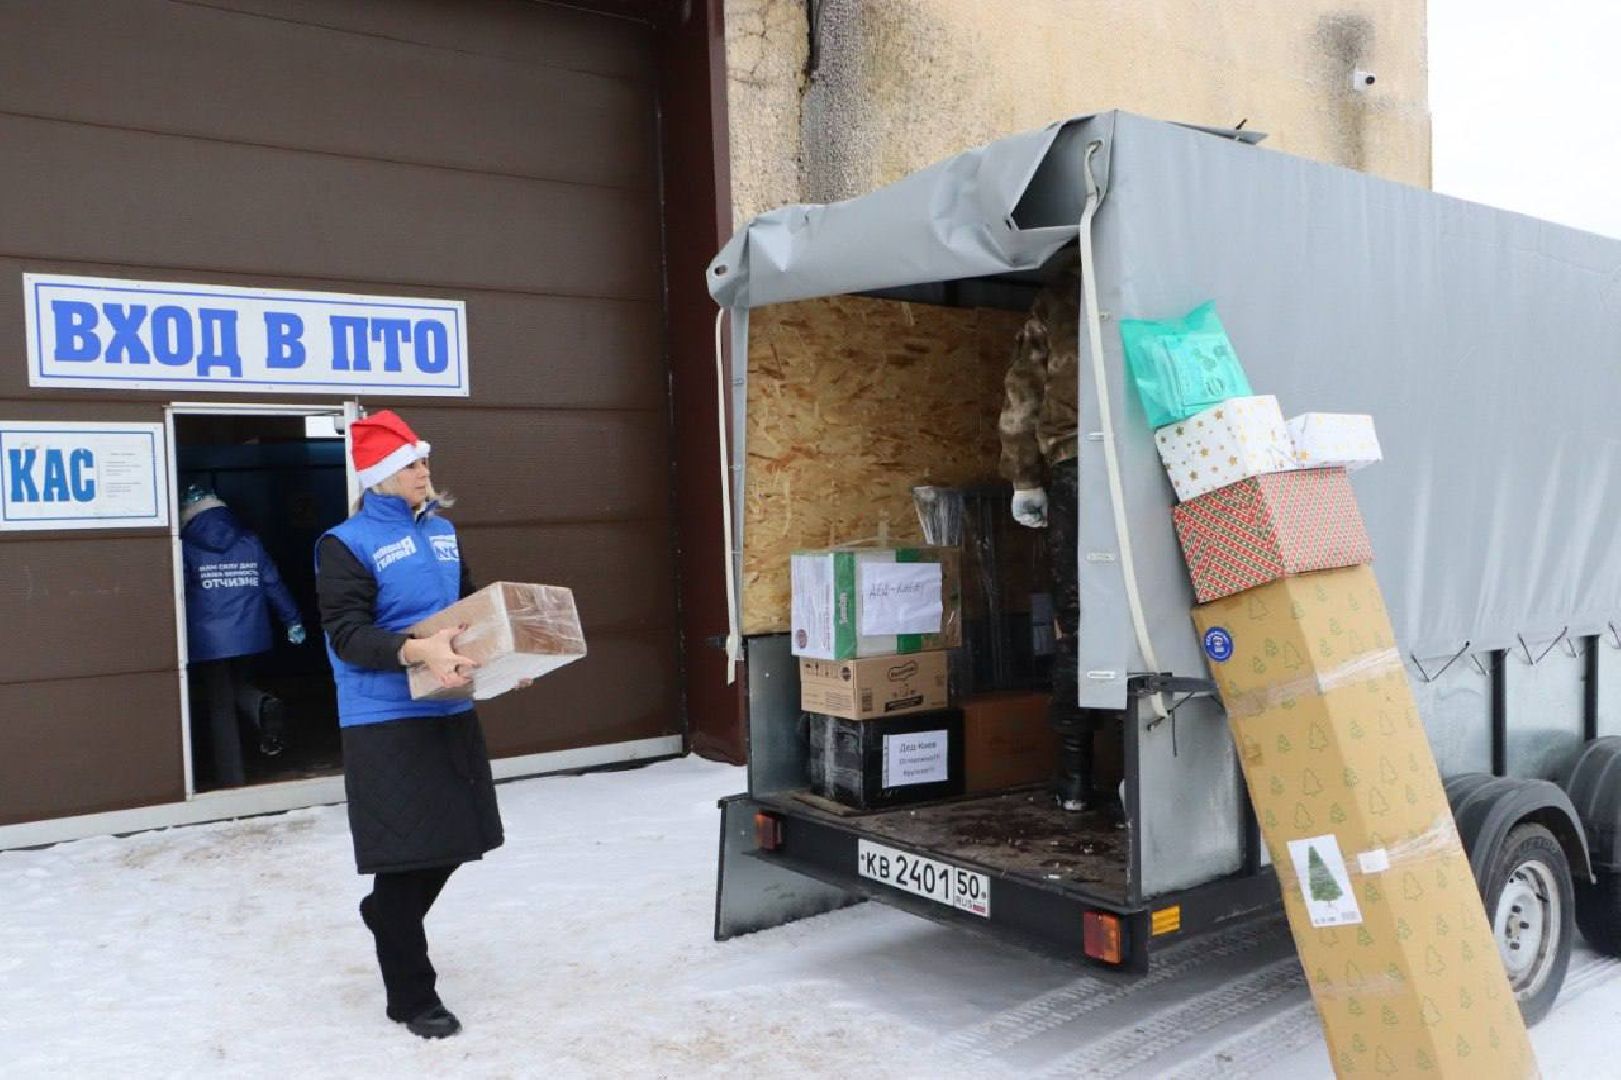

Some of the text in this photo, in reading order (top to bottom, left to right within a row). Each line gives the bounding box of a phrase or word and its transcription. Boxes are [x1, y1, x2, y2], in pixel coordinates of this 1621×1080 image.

[50, 299, 449, 378] ВХОД В ПТО
[8, 448, 96, 503] КАС
[202, 577, 259, 588] ОТЧИЗНЕ
[895, 854, 949, 901] 2401
[957, 871, 980, 899] 50
